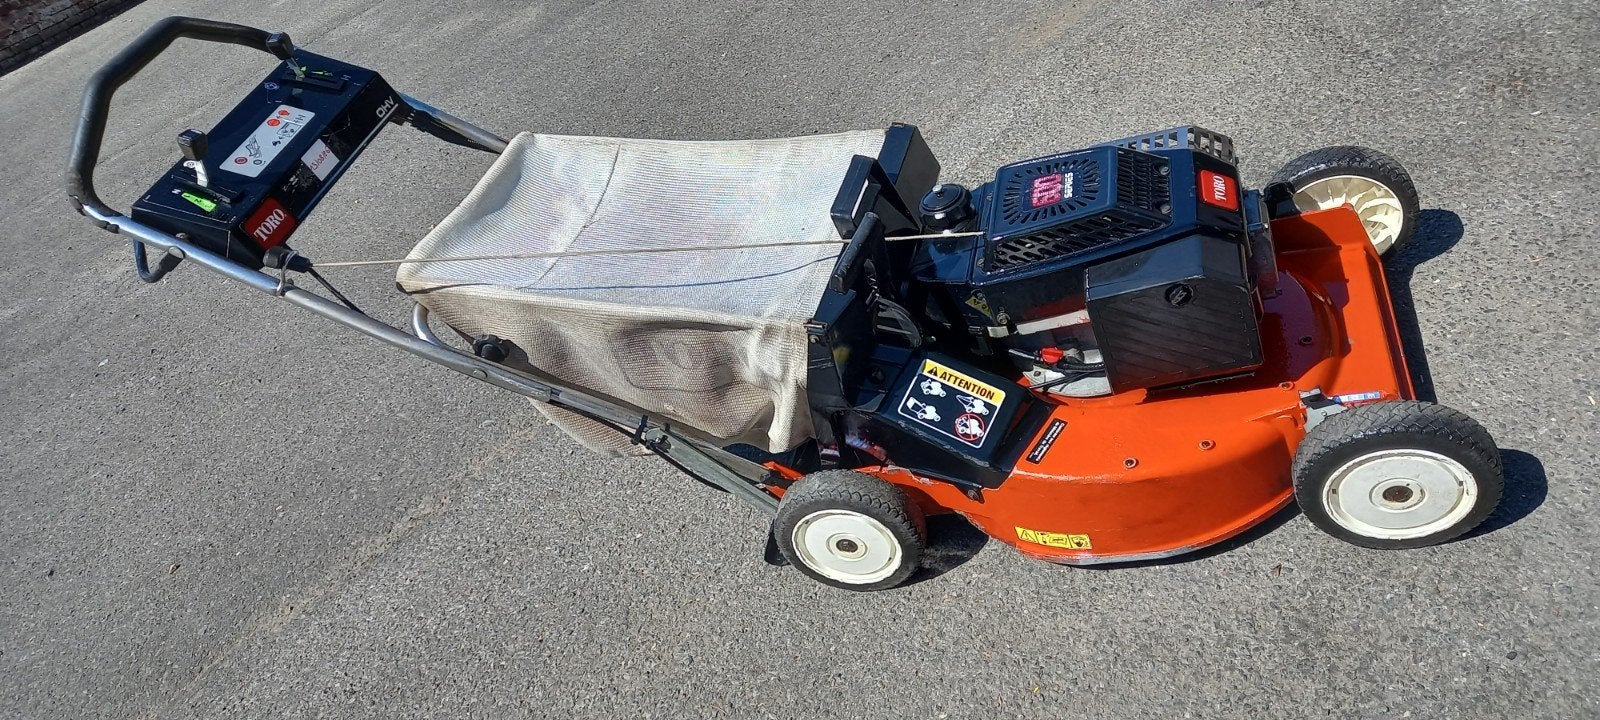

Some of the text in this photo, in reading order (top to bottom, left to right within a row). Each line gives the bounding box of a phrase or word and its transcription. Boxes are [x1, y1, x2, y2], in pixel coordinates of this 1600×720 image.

[376, 95, 394, 118] OHV
[1064, 172, 1074, 198] SERIES
[1213, 175, 1227, 202] TORO
[253, 208, 285, 242] TORO
[939, 371, 995, 400] ATTENTION
